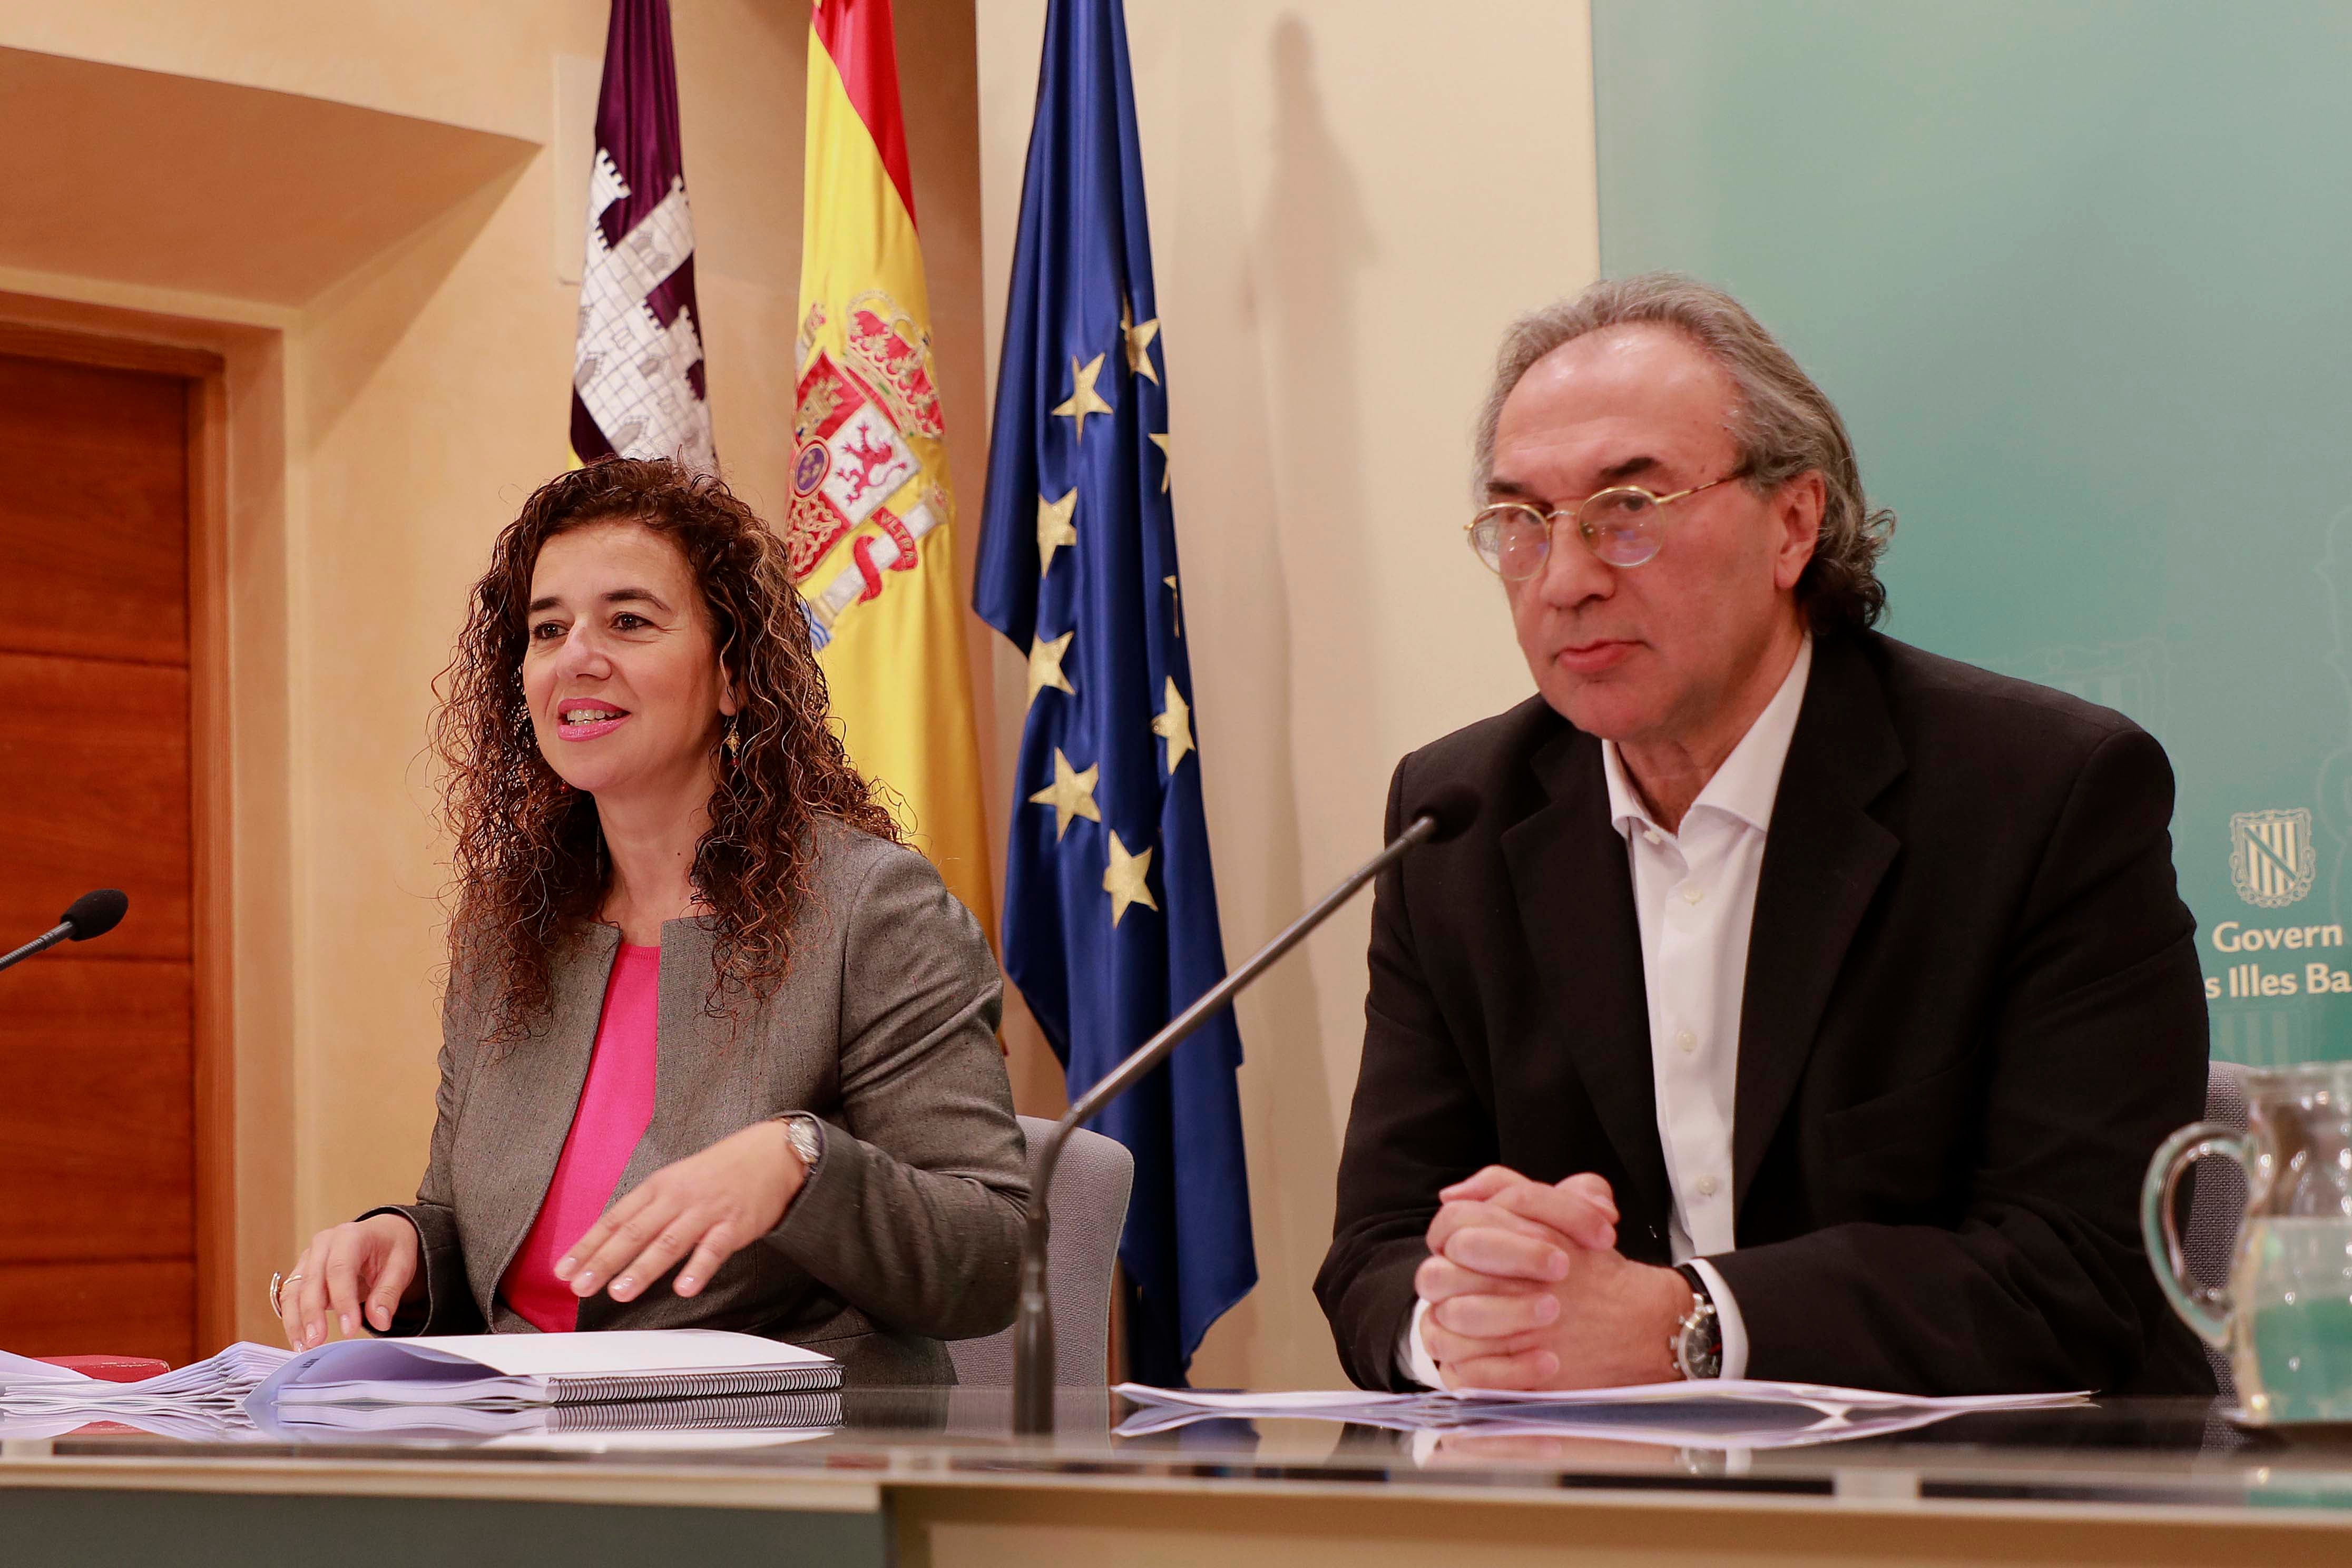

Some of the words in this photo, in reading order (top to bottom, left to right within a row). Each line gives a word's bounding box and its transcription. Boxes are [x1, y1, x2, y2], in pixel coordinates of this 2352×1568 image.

[2212, 921, 2344, 953] Govern
[2228, 963, 2298, 997] Illes
[2305, 962, 2352, 995] Ba
